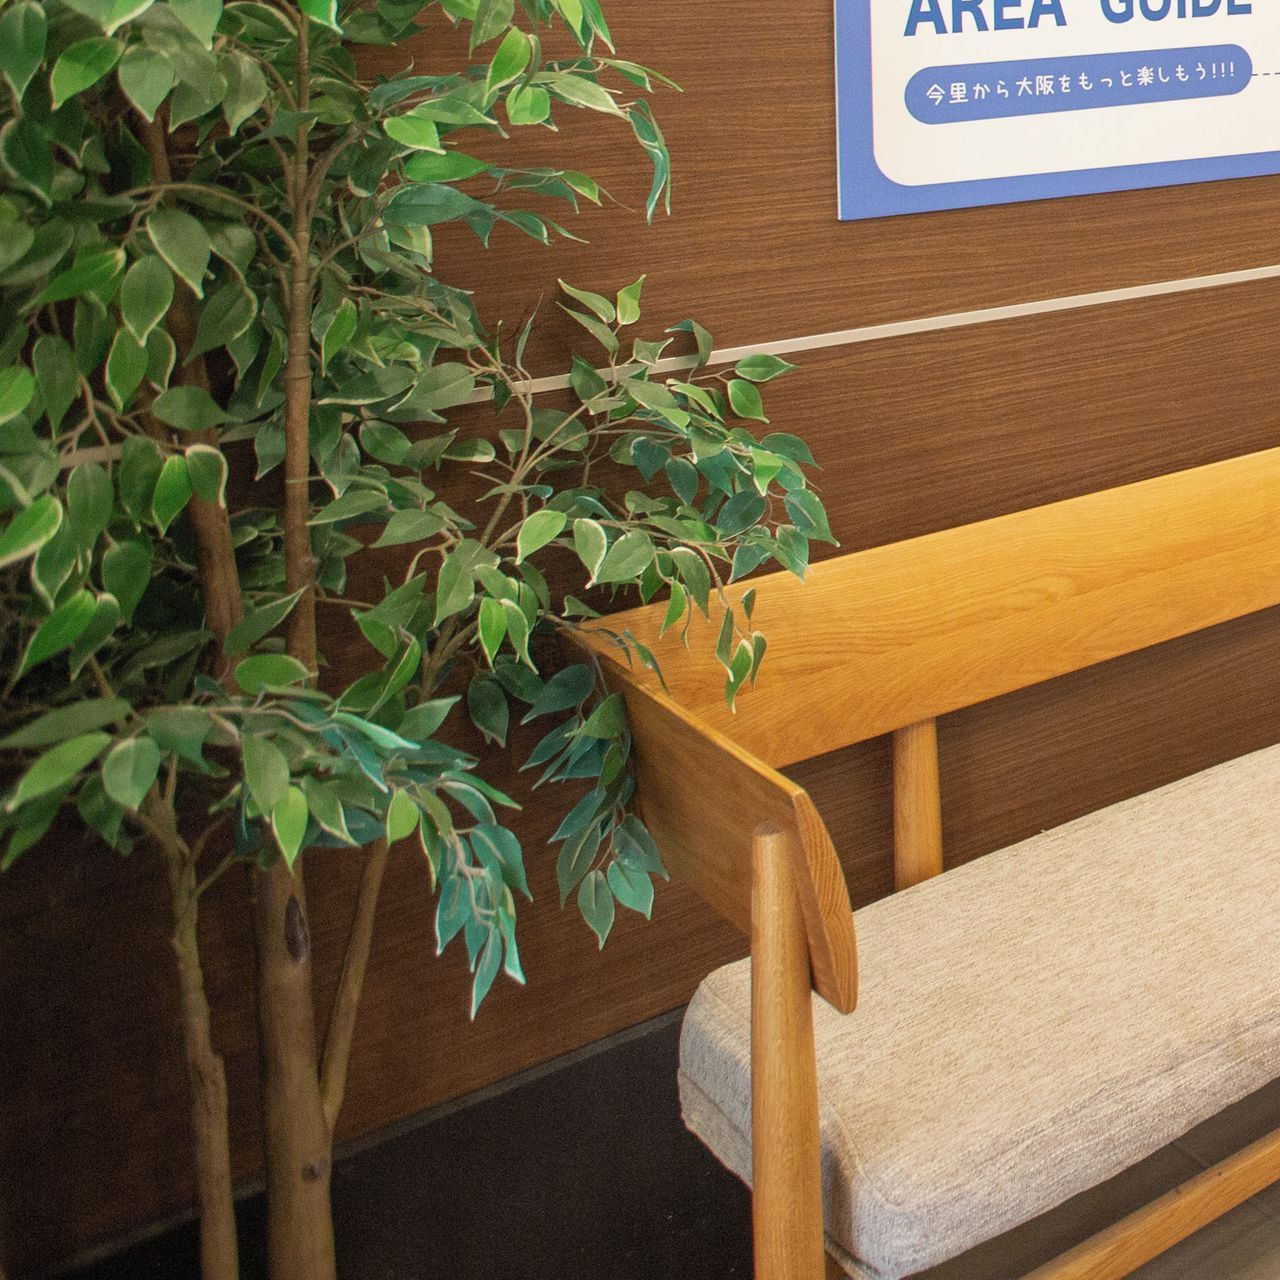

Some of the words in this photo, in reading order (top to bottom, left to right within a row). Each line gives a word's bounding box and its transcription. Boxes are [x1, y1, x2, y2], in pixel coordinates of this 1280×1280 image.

[924, 60, 1236, 107] 今里から大阪をもっと楽しもう!!!
